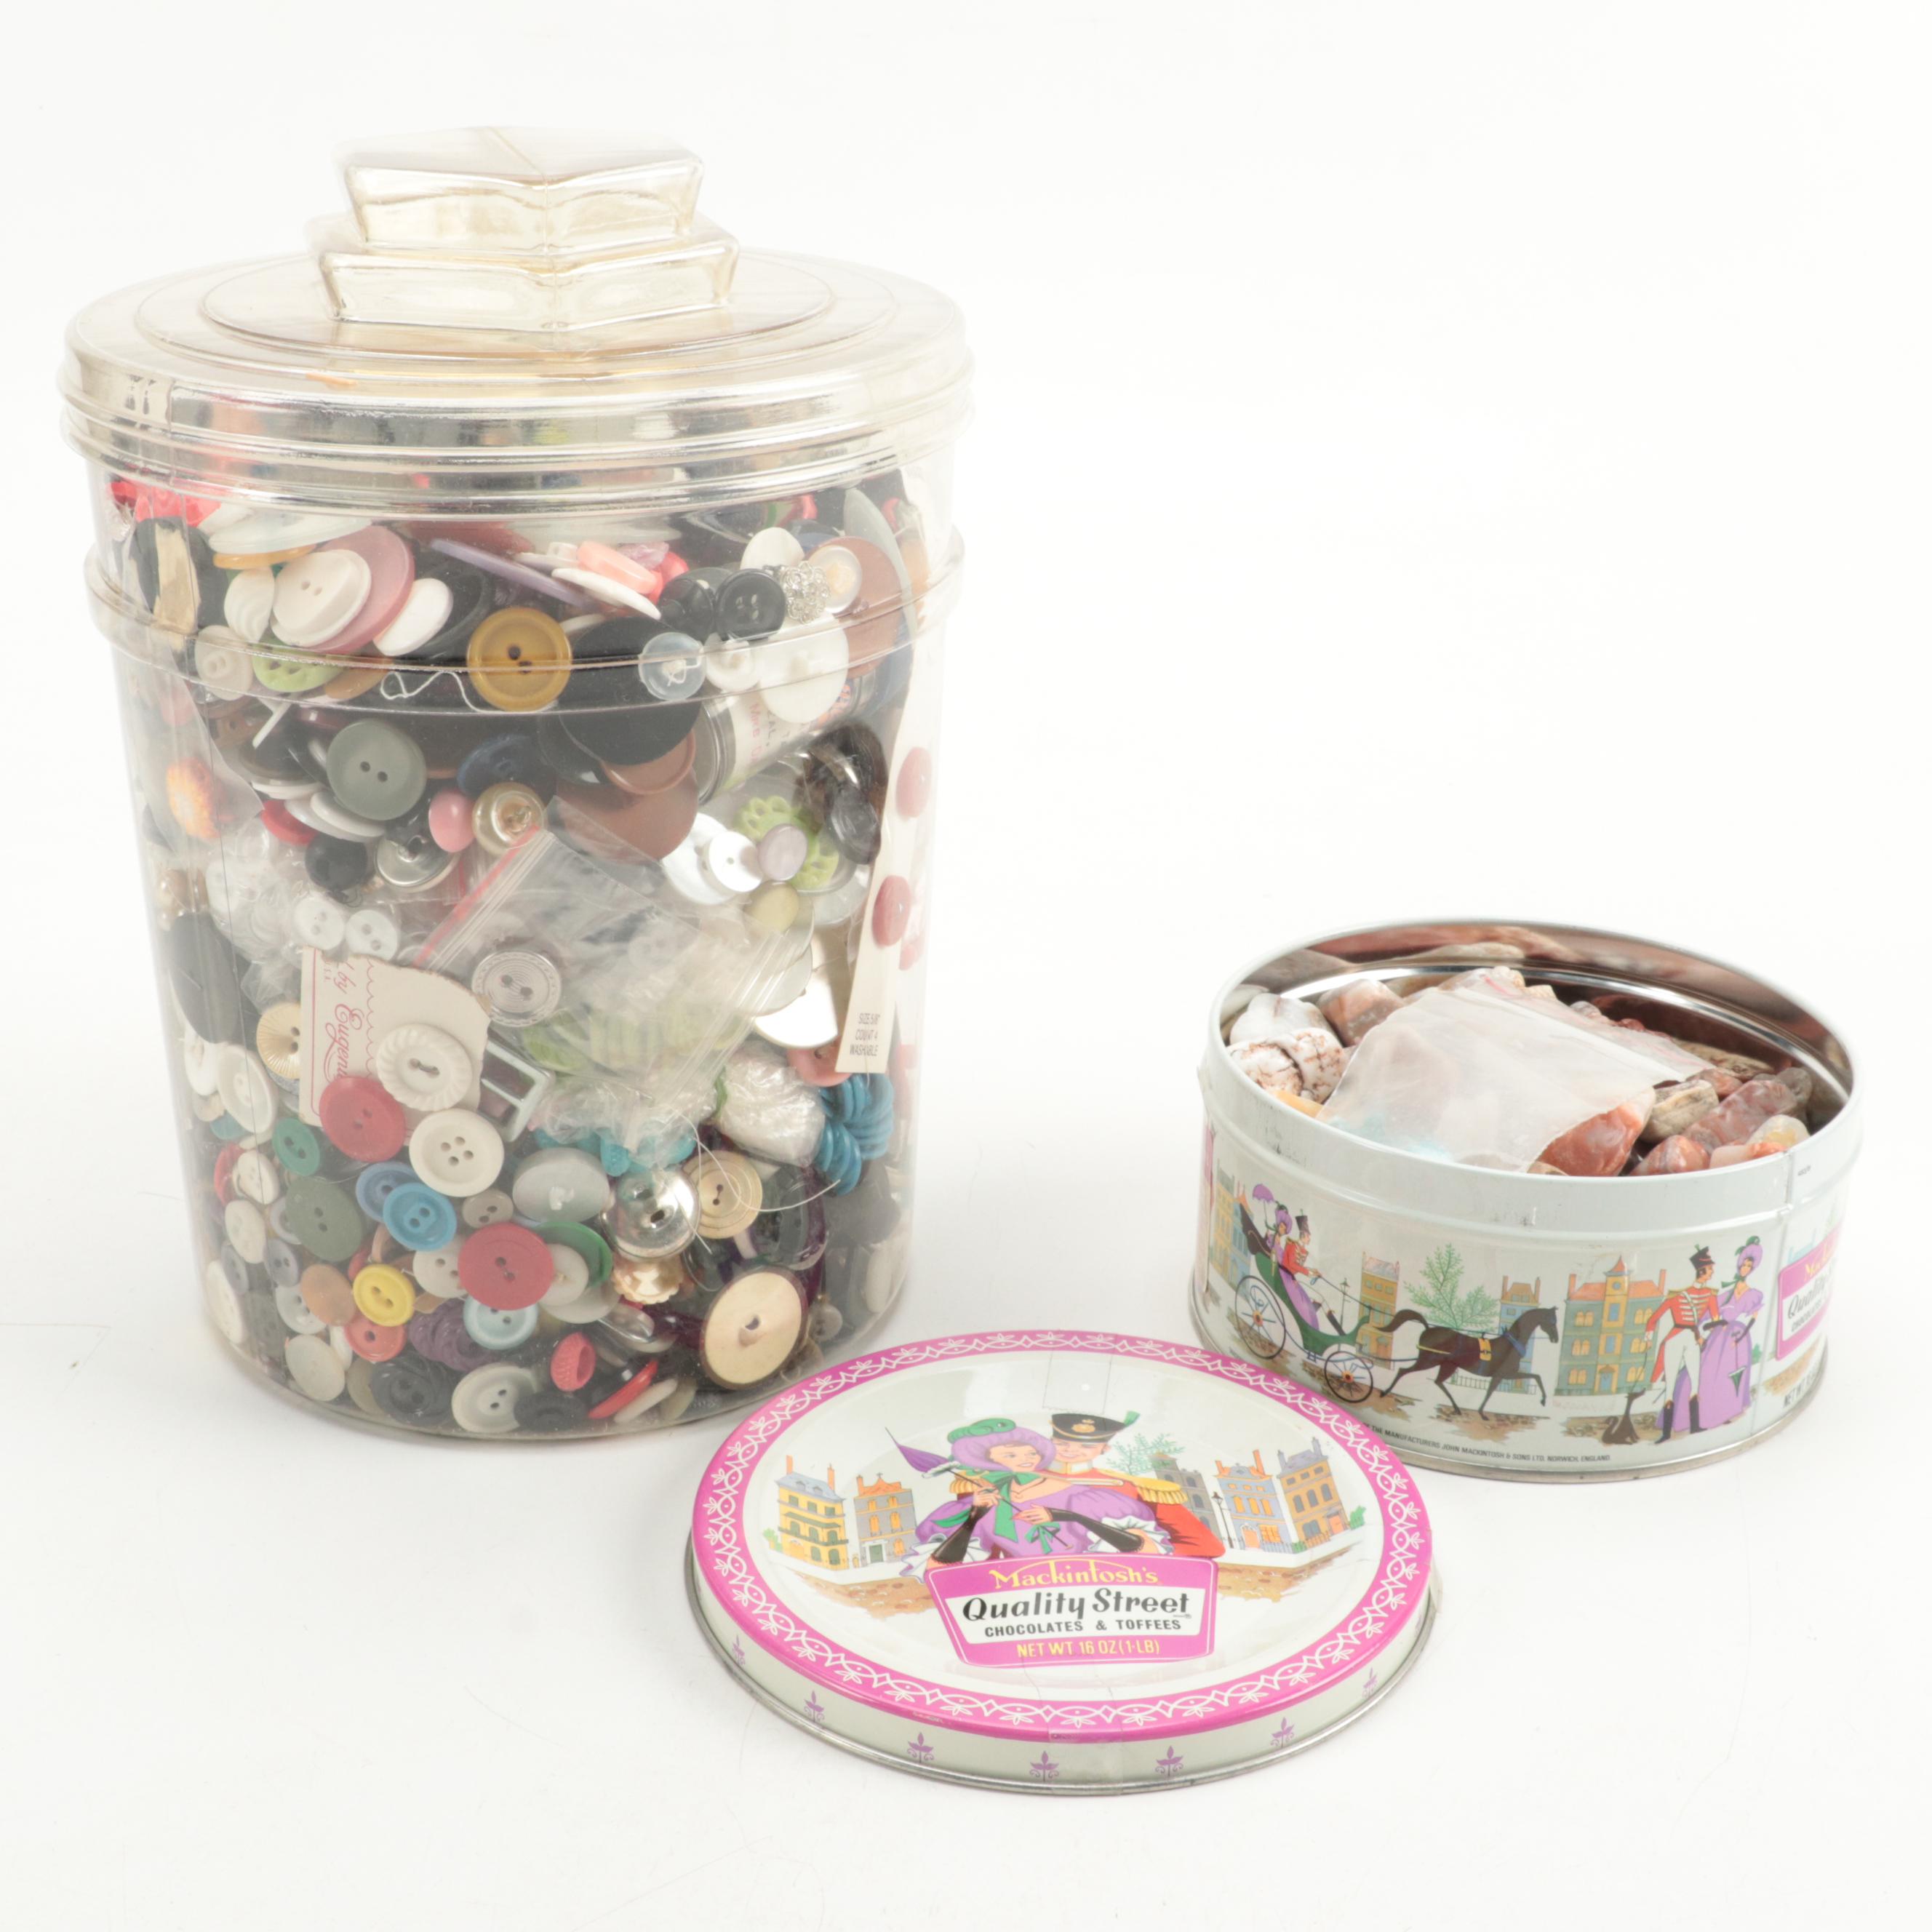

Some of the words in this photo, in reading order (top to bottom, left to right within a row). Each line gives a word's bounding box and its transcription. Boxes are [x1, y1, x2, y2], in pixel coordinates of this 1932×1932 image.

[850, 1043, 879, 1057] WASHABLE
[1384, 1429, 1441, 1449] MANUFACTURERS
[1441, 1442, 1461, 1453] JOHN
[1461, 1447, 1505, 1459] MACKINTOSH
[1512, 1453, 1530, 1461] SONS
[989, 1558, 1159, 1589] Mackintosh's
[962, 1591, 1086, 1621] Quality
[1092, 1587, 1190, 1614] Street
[984, 1620, 1084, 1638] CHOCOLATES
[1095, 1619, 1108, 1631] &
[1115, 1619, 1181, 1631] TOFFEES
[1016, 1642, 1044, 1658] NET
[1047, 1641, 1074, 1656] WT
[1079, 1640, 1095, 1655] 16
